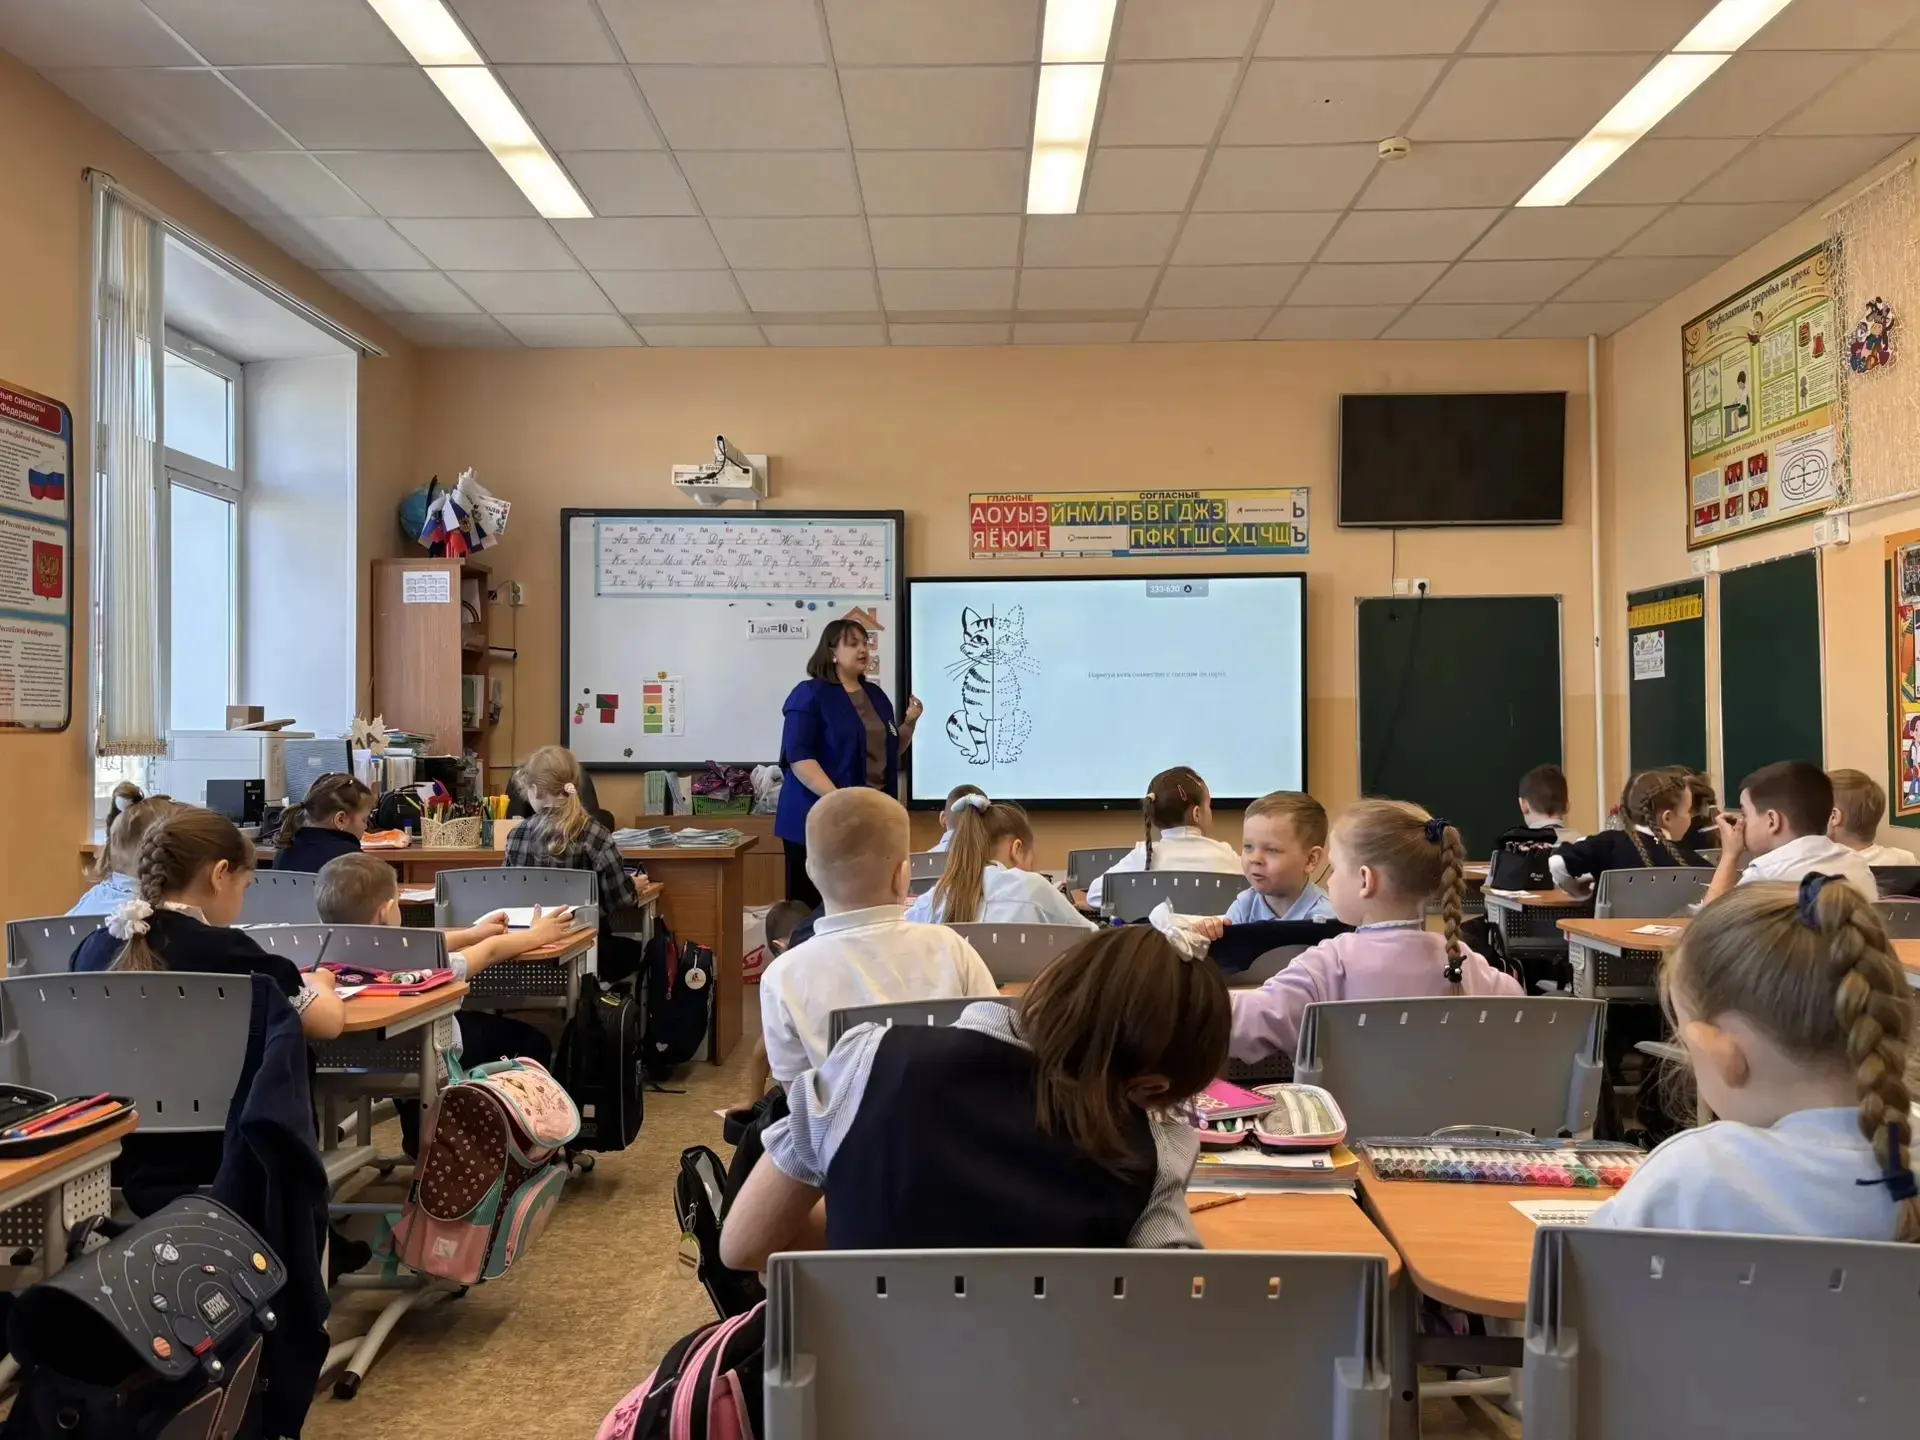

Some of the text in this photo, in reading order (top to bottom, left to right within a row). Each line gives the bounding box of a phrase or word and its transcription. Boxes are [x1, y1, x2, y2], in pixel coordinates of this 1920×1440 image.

[14, 396, 46, 413] символы
[0, 402, 40, 424] Федерации
[986, 494, 1034, 502] ГЛАСНЫЕ
[1139, 491, 1201, 499] СОГЛАСНЫЕ
[1292, 501, 1305, 518] Ь
[750, 623, 755, 633] 1
